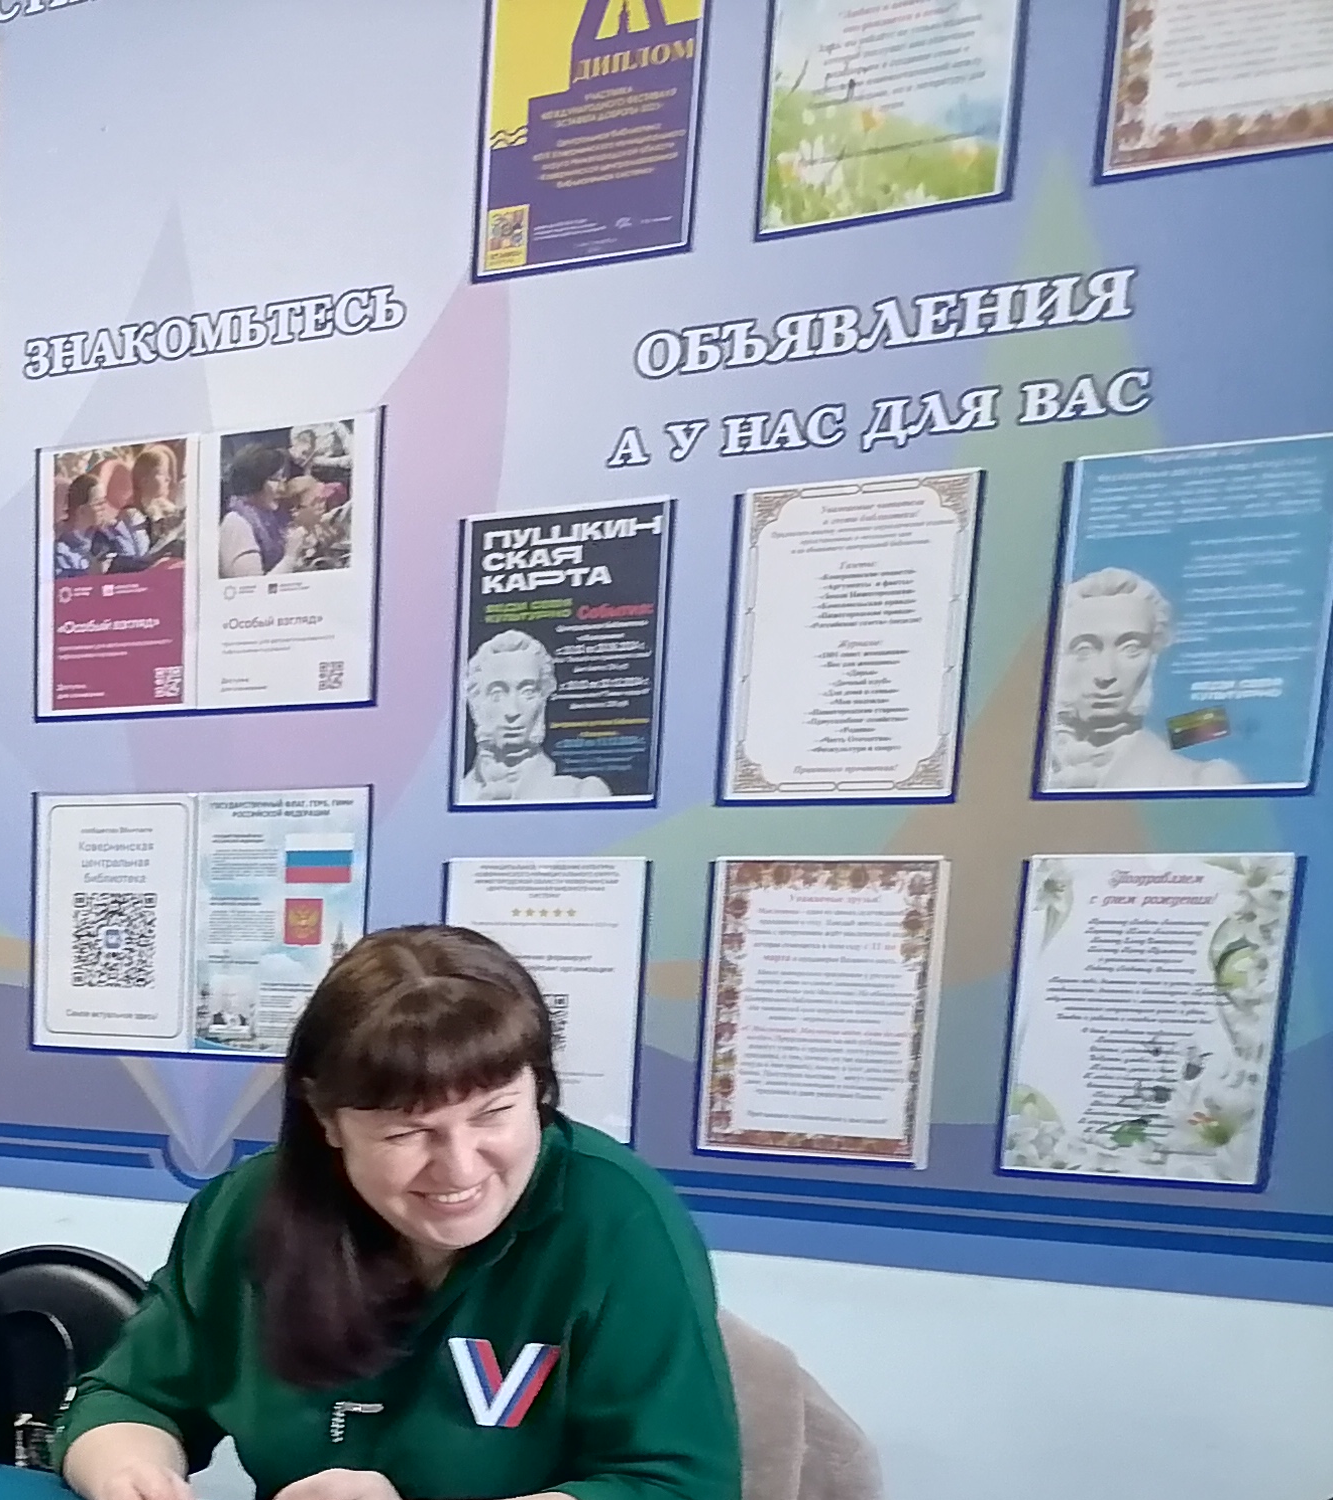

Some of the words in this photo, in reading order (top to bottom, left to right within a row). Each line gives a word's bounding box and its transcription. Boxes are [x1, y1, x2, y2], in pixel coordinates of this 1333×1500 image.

[572, 38, 695, 84] ДИПЛОМ
[24, 285, 408, 379] ЗНАКОМЬТЕСЬ
[634, 267, 1138, 380] ОБЪЯВЛЕНИЯ
[607, 427, 650, 468] А
[664, 420, 708, 462] У
[719, 405, 846, 458] НАС
[861, 386, 1001, 451] ДЛЯ
[1017, 369, 1153, 425] ВАС
[481, 544, 584, 572] СКАЯ
[481, 566, 613, 594] КАРТА
